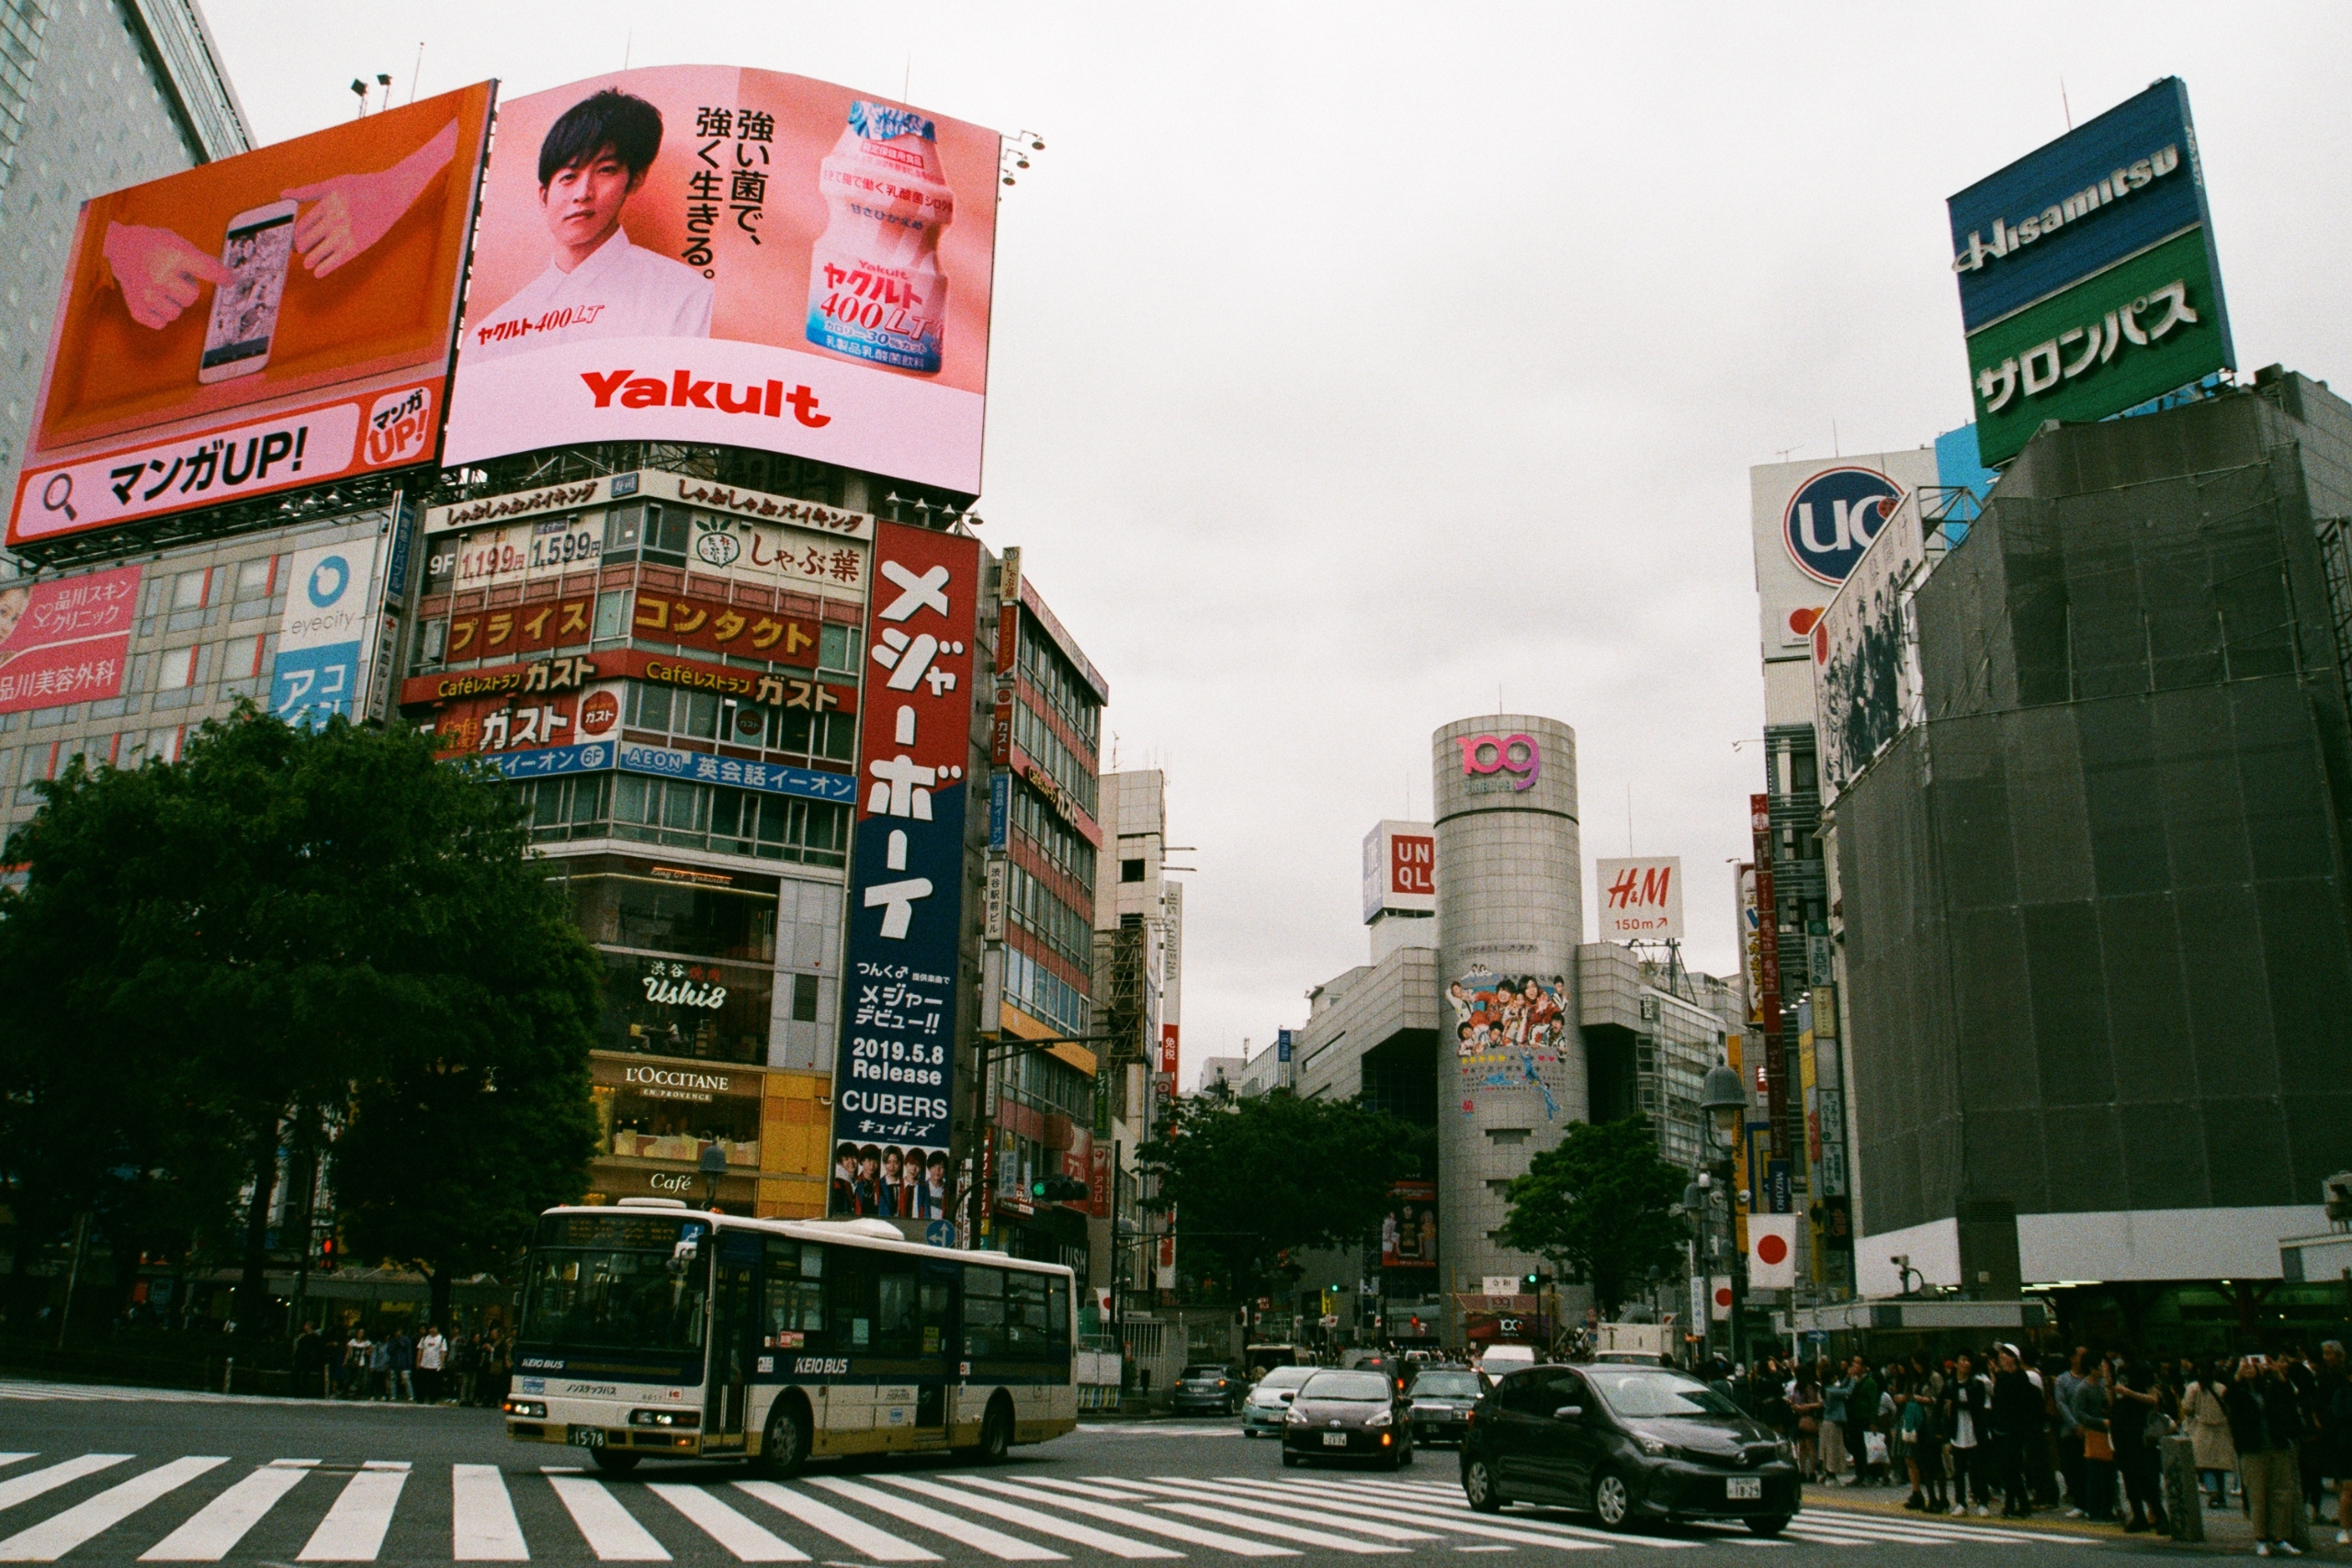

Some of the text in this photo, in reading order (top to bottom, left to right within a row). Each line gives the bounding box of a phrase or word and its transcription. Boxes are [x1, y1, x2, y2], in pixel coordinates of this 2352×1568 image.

[681, 107, 732, 279] 強く生きる。
[731, 110, 775, 246] 強い菌で、
[1951, 143, 2179, 273] Hisamitsu
[823, 263, 922, 309] ヤクルト
[1976, 279, 2199, 413] サロンパス
[373, 389, 424, 430] マンガ
[580, 369, 831, 428] Yakult
[368, 411, 428, 463] UP!
[109, 426, 310, 505] マンガUP!
[679, 479, 864, 532] しゃぶしゃぶバイキング
[430, 554, 455, 575] 9F
[752, 534, 860, 582] しゃぶ葉
[54, 581, 132, 611] 品川スキン
[51, 604, 119, 635] クリニック
[291, 610, 356, 638] eyecity
[452, 603, 588, 651] プライス
[636, 595, 813, 654] コンタクト
[0, 658, 117, 701] 品川美容外科
[525, 657, 595, 692] ガスト
[755, 675, 838, 713] ガスト
[480, 705, 568, 751] ガスト
[585, 710, 614, 723] ガスト
[582, 748, 602, 766] 6F
[864, 559, 964, 940] メジャーボーイ
[997, 720, 1009, 757] ガスト
[628, 750, 852, 796] AEON 英会話イーオン
[1456, 733, 1540, 791] 109
[989, 867, 1001, 934] 渋谷駅前ビル
[1607, 866, 1670, 908] H&M
[642, 976, 727, 1009] Ushi8
[859, 983, 943, 1008] メジャー
[854, 1005, 941, 1034] デビュー!!
[853, 1037, 944, 1065] 2019.5.8
[1164, 1037, 1175, 1060] 免税
[626, 1066, 729, 1091] L'OCCITANE
[853, 1058, 942, 1085] Release
[1097, 1072, 1105, 1096] レイク
[661, 1090, 711, 1101] PROVENCE
[842, 1089, 947, 1120] CUBERS
[858, 1119, 935, 1137] キューバーズ
[650, 1173, 692, 1193] Café
[521, 1358, 564, 1370] KEIO BUS
[794, 1357, 849, 1374] KEIO BUS
